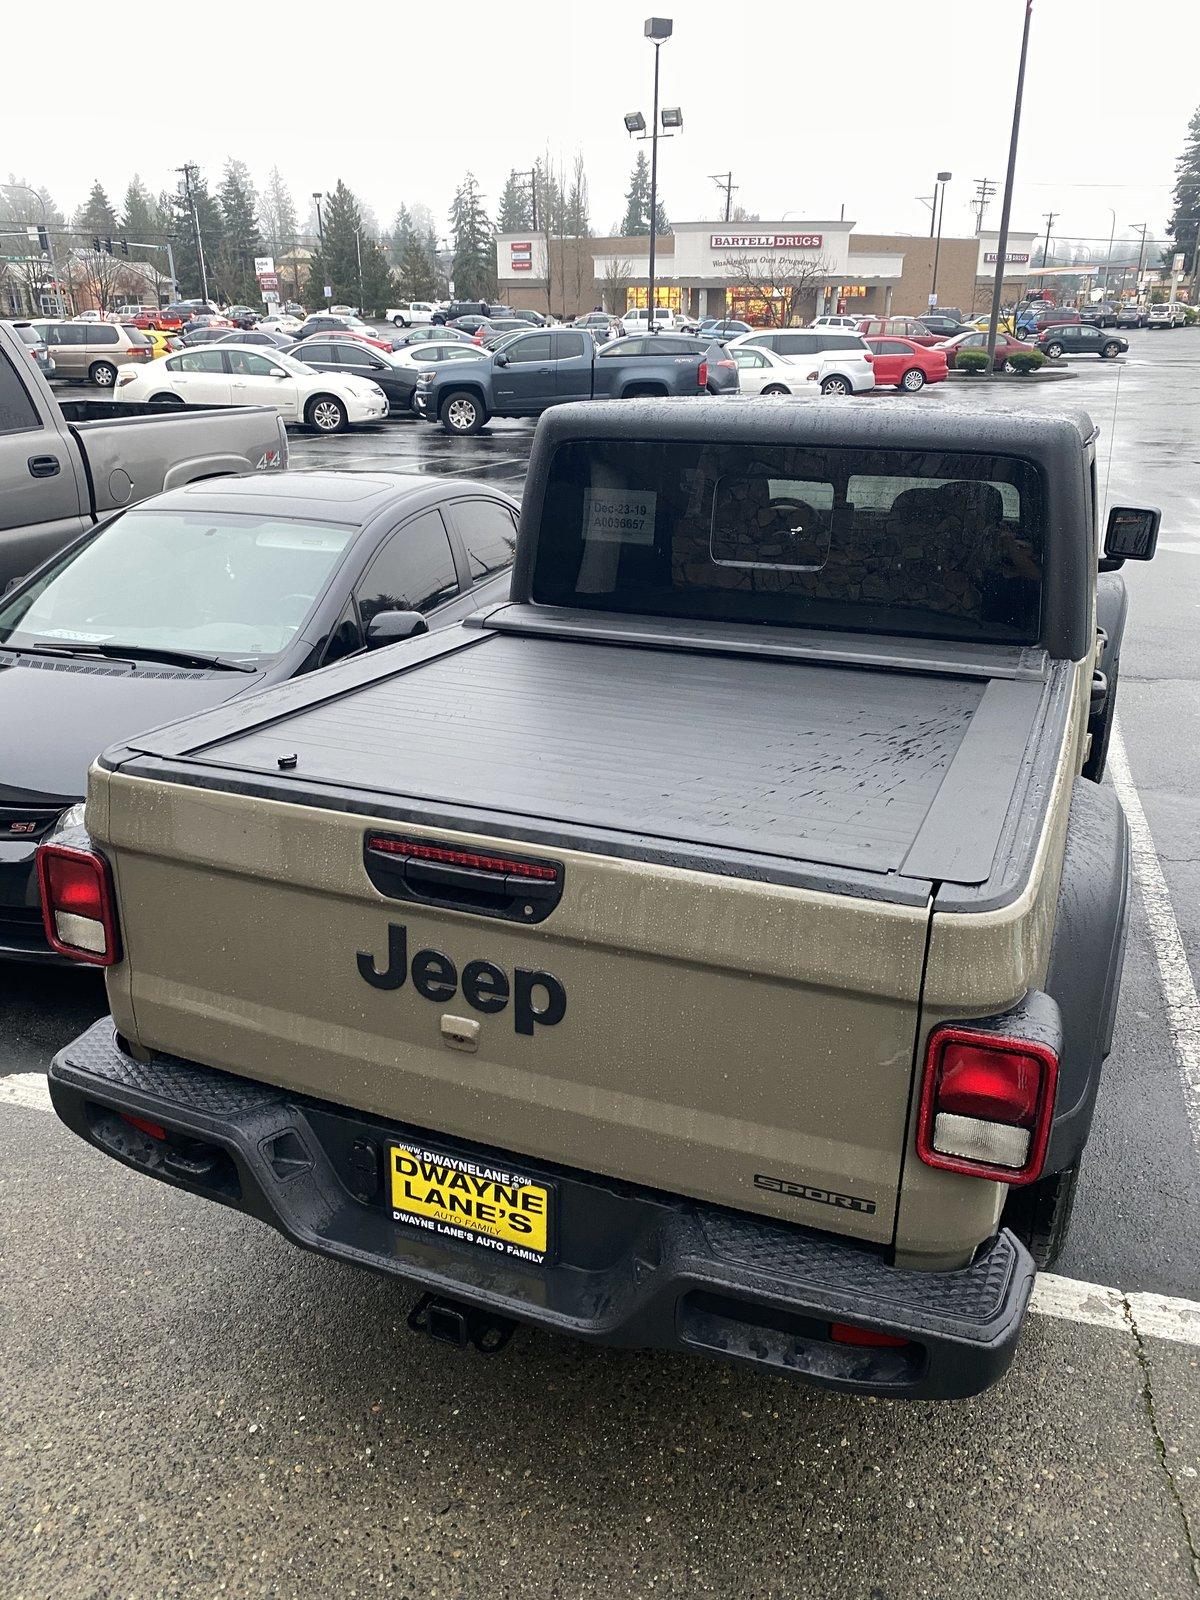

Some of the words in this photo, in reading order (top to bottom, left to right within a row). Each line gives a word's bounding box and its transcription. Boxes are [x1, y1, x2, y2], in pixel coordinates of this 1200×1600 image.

[714, 237, 773, 246] BARTELL
[775, 236, 820, 246] DRUGS
[593, 518, 645, 530] A0036657
[594, 503, 647, 516] Dec-23-19
[356, 921, 567, 1036] Jeep
[395, 1155, 544, 1215] DWAYNE
[754, 1174, 877, 1215] SPORT
[404, 1181, 533, 1234] LANE'S
[433, 1210, 463, 1225] AUTO
[464, 1219, 502, 1236] FAMILY
[392, 1210, 435, 1231] DWAYNE
[437, 1223, 475, 1242] LANE'S
[476, 1235, 504, 1252] AUTO
[506, 1245, 545, 1264] FAMILY
